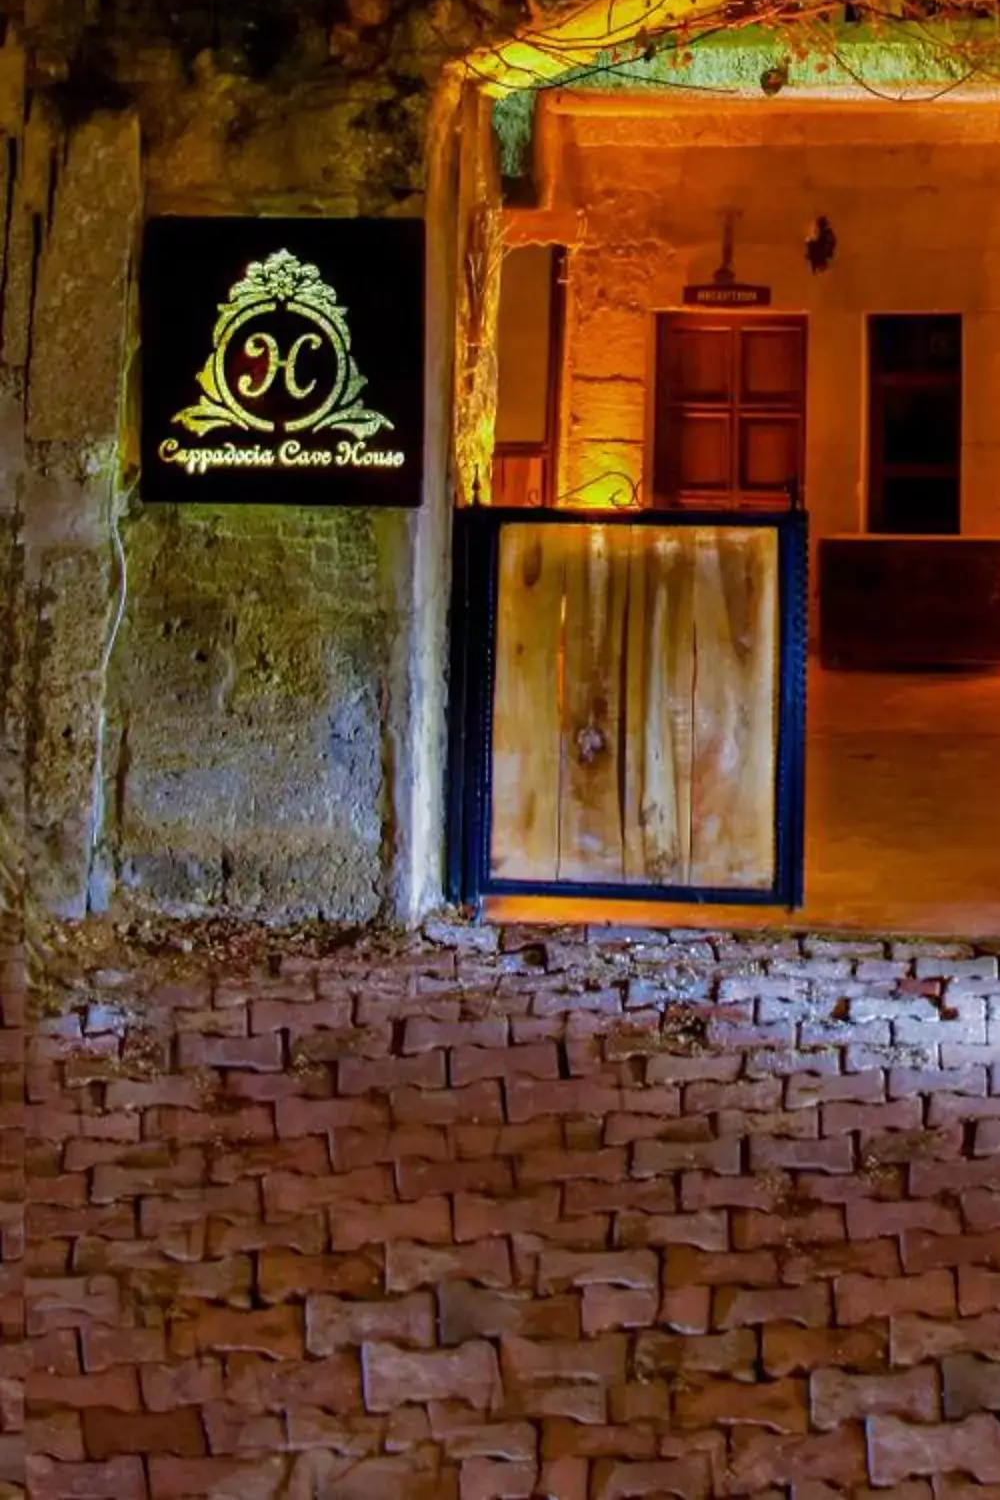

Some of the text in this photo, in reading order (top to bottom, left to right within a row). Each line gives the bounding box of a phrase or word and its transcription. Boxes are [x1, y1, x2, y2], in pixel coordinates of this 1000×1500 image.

[158, 438, 406, 476] Cappadocia Cave House
